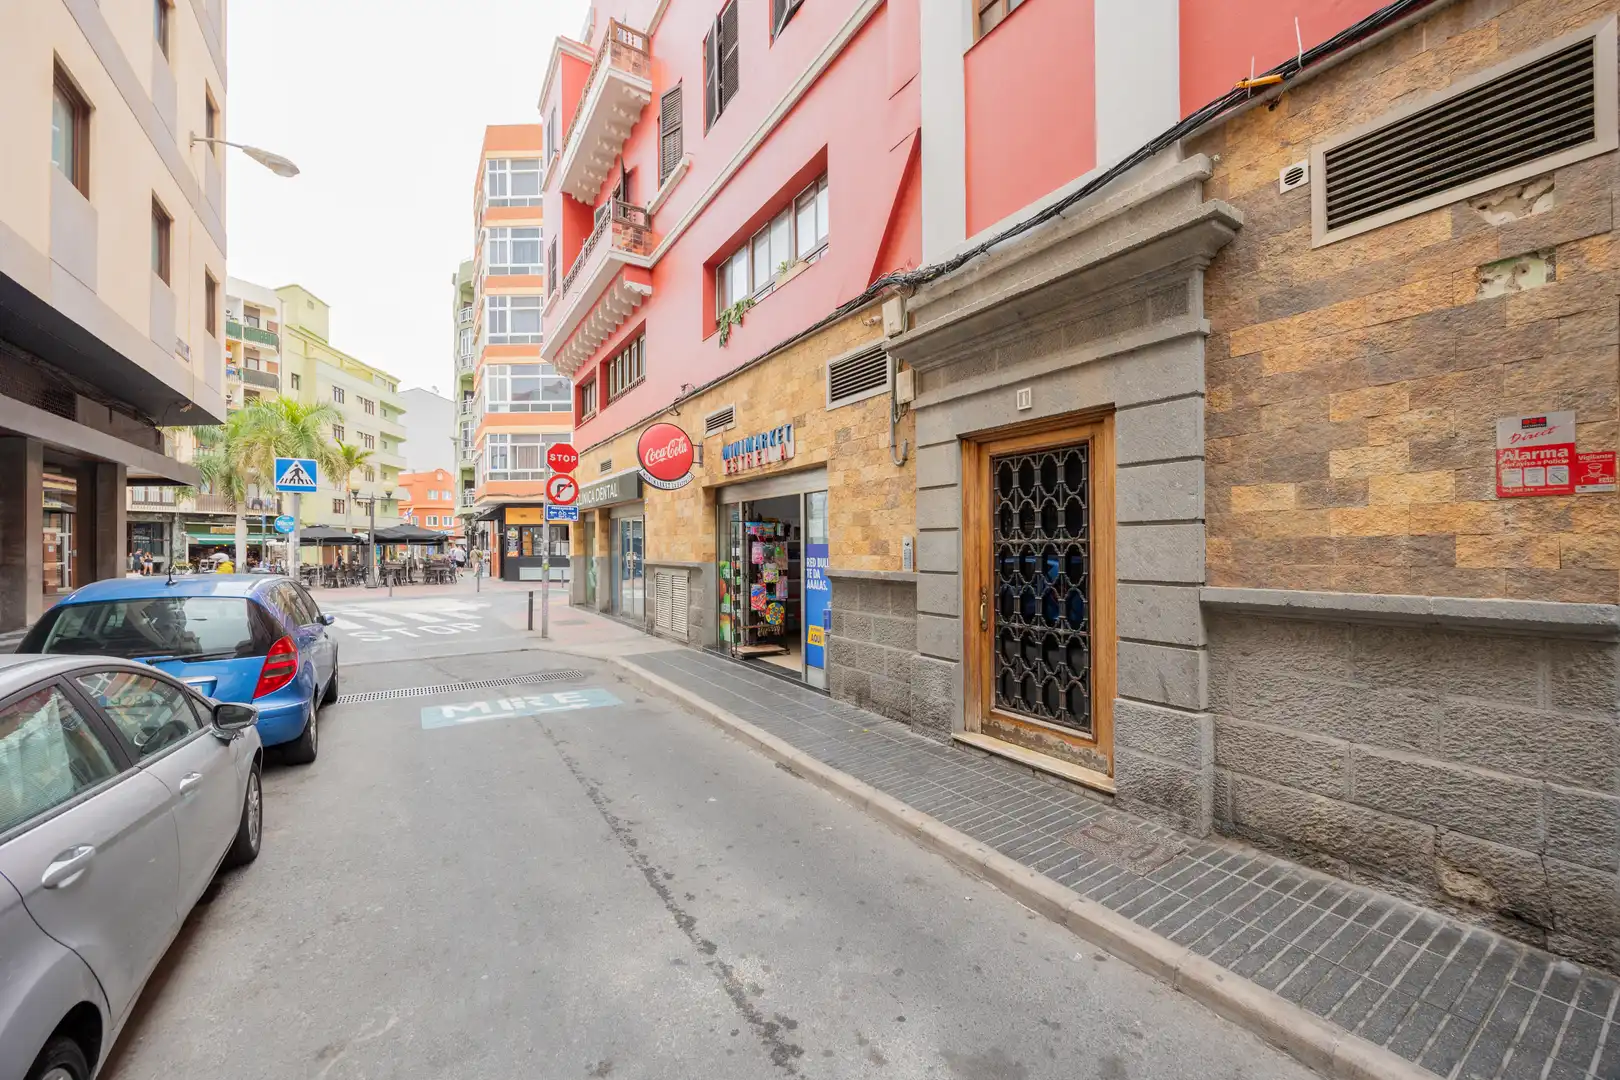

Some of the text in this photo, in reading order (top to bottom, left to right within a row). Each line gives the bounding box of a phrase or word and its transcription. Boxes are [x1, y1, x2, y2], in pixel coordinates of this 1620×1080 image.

[722, 424, 792, 461] MINIMARKET
[1508, 425, 1561, 445] Direct
[549, 453, 577, 463] STOP
[645, 436, 688, 467] Coca-Cola
[724, 443, 787, 475] ESTRELA
[1501, 448, 1569, 462] Alarma
[595, 483, 619, 502] DENTAL
[807, 557, 817, 568] RED
[807, 568, 821, 579] TE DA
[349, 622, 482, 642] STOP
[441, 691, 588, 718] MIRE
